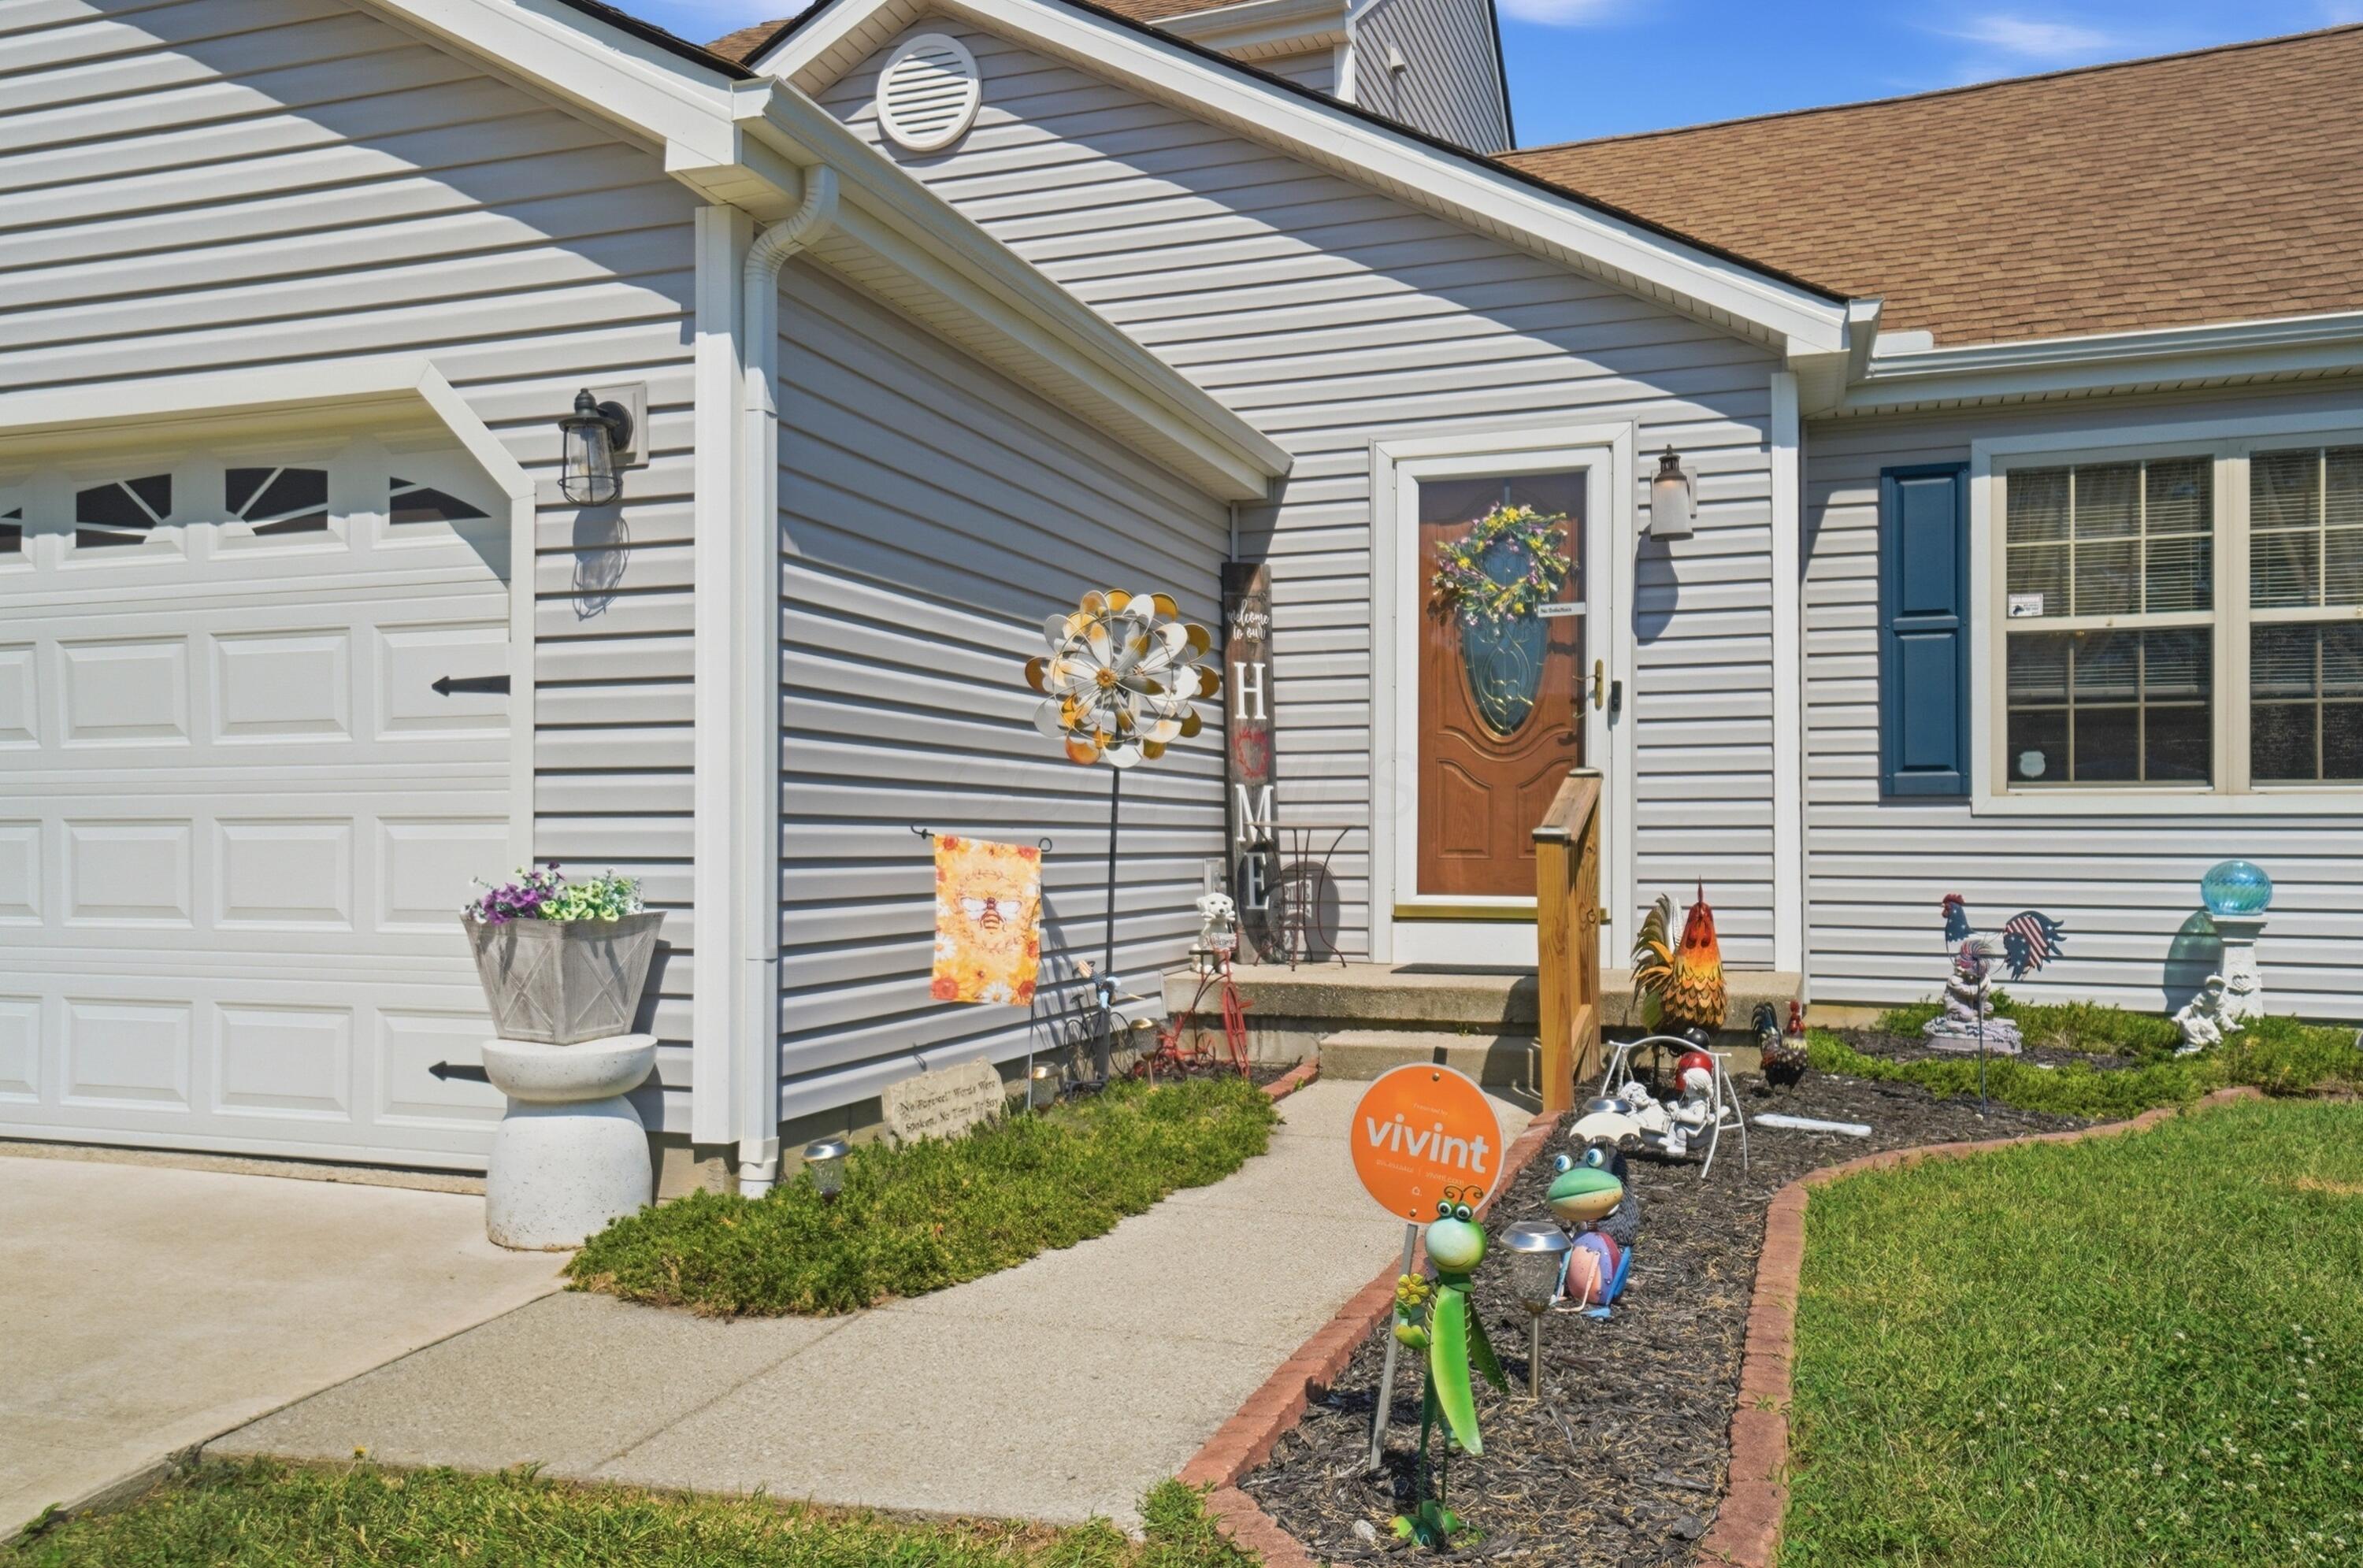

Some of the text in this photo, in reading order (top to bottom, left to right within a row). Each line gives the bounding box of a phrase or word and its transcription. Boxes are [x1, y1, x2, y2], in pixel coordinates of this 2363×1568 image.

[1227, 599, 1270, 627] welcome
[1233, 622, 1266, 640] to our
[1367, 1114, 1489, 1173] vivint
